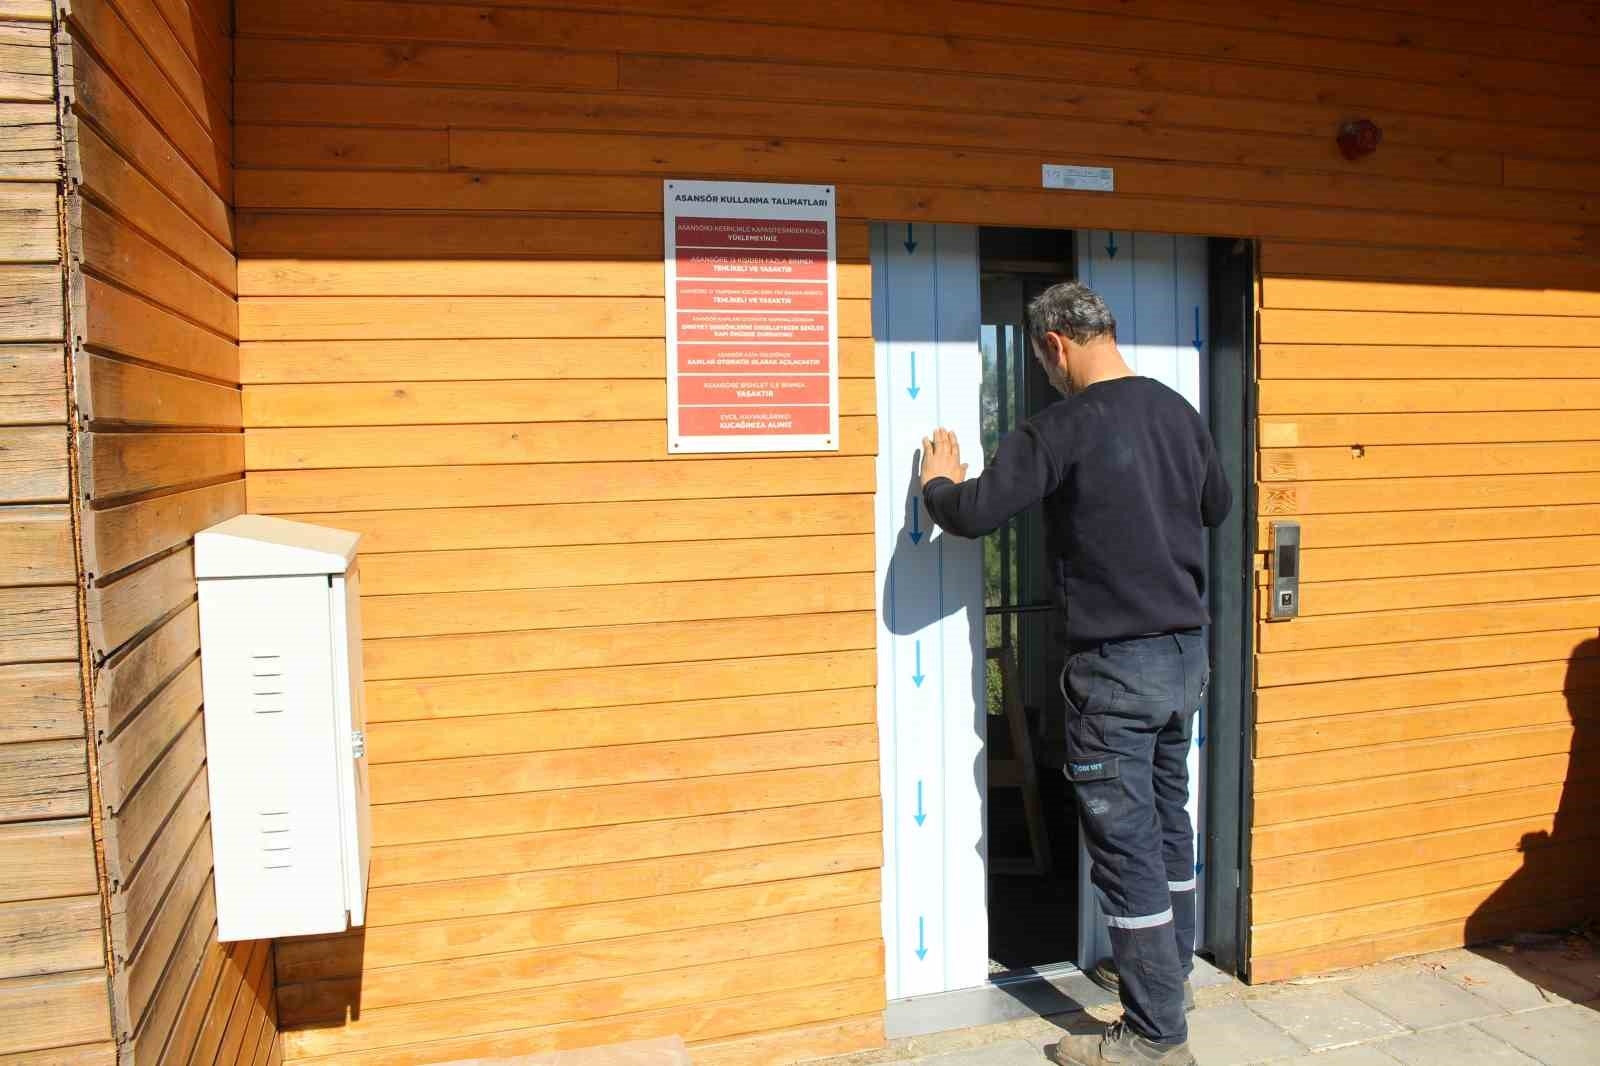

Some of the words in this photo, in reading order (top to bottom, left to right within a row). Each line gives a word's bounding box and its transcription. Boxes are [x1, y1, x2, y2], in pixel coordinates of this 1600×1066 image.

[675, 193, 718, 202] ASANSÖR
[720, 195, 770, 204] KULLANMA
[736, 390, 774, 398] YASAKTIR
